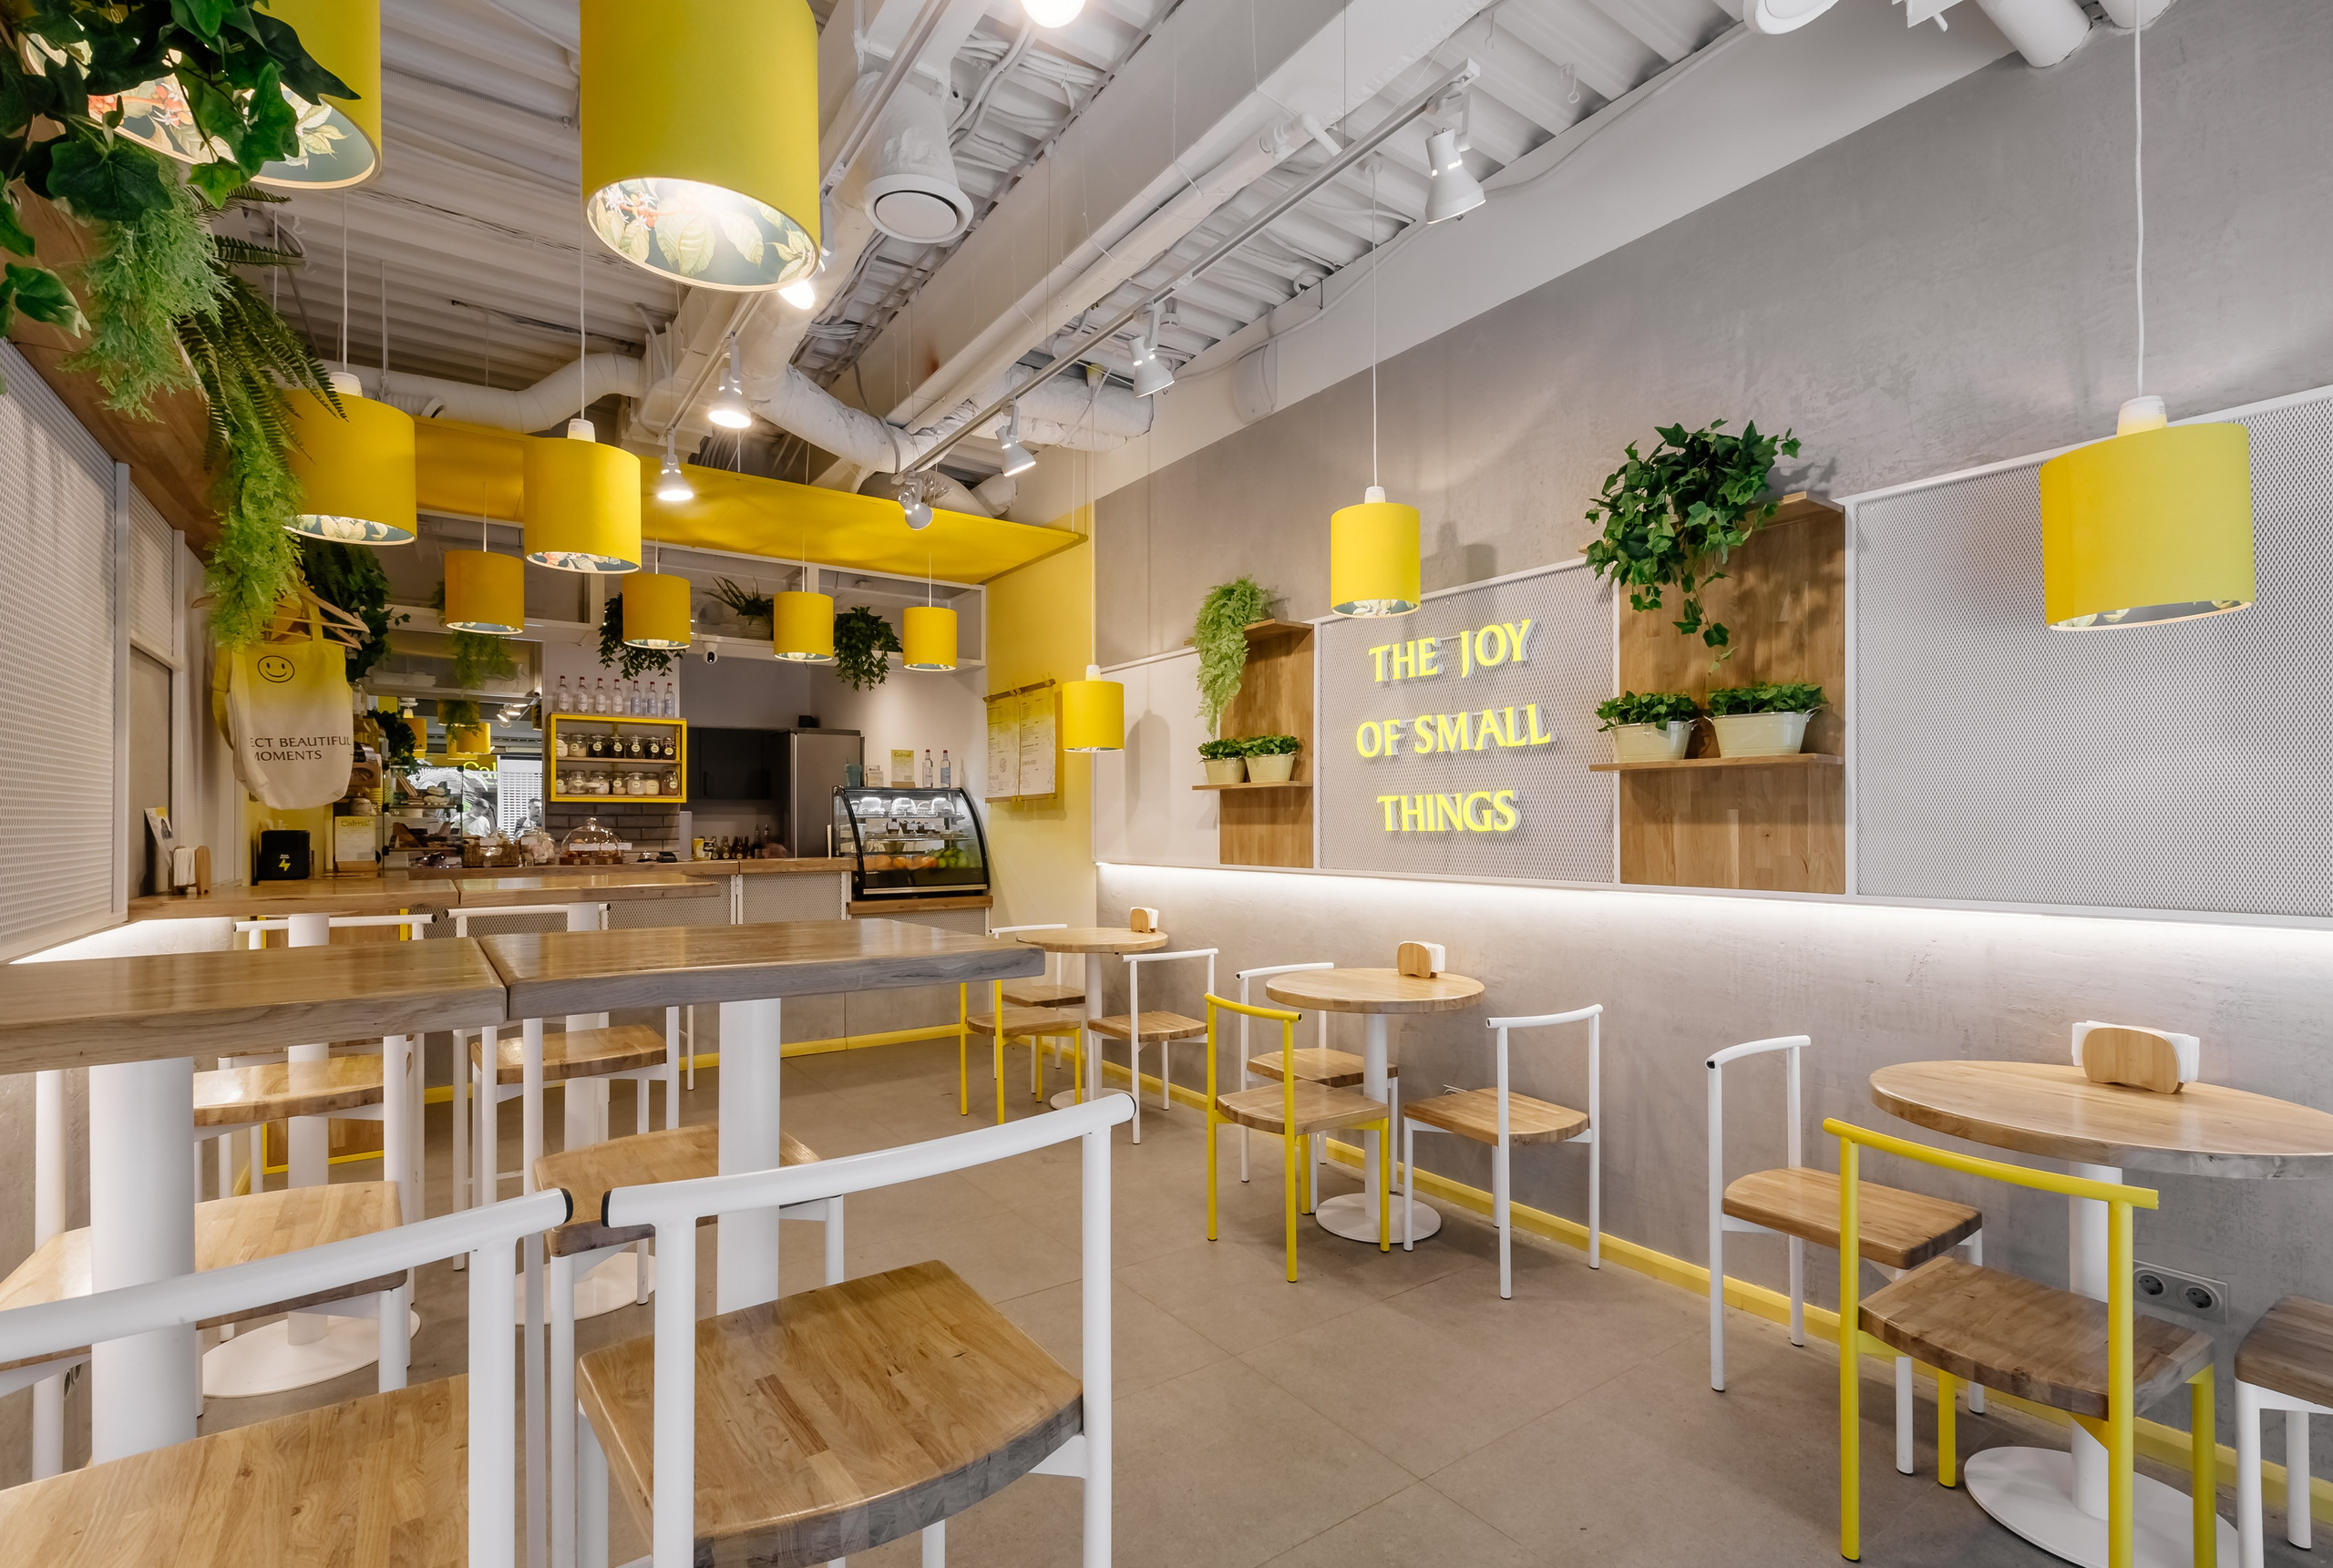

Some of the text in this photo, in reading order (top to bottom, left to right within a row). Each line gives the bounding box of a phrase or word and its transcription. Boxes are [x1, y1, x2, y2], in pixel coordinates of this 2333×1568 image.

[1368, 619, 1533, 682] THE JOY
[279, 735, 352, 748] BEAUTIFUL
[1356, 703, 1552, 758] OF SMALL
[1376, 789, 1517, 833] THINGS
